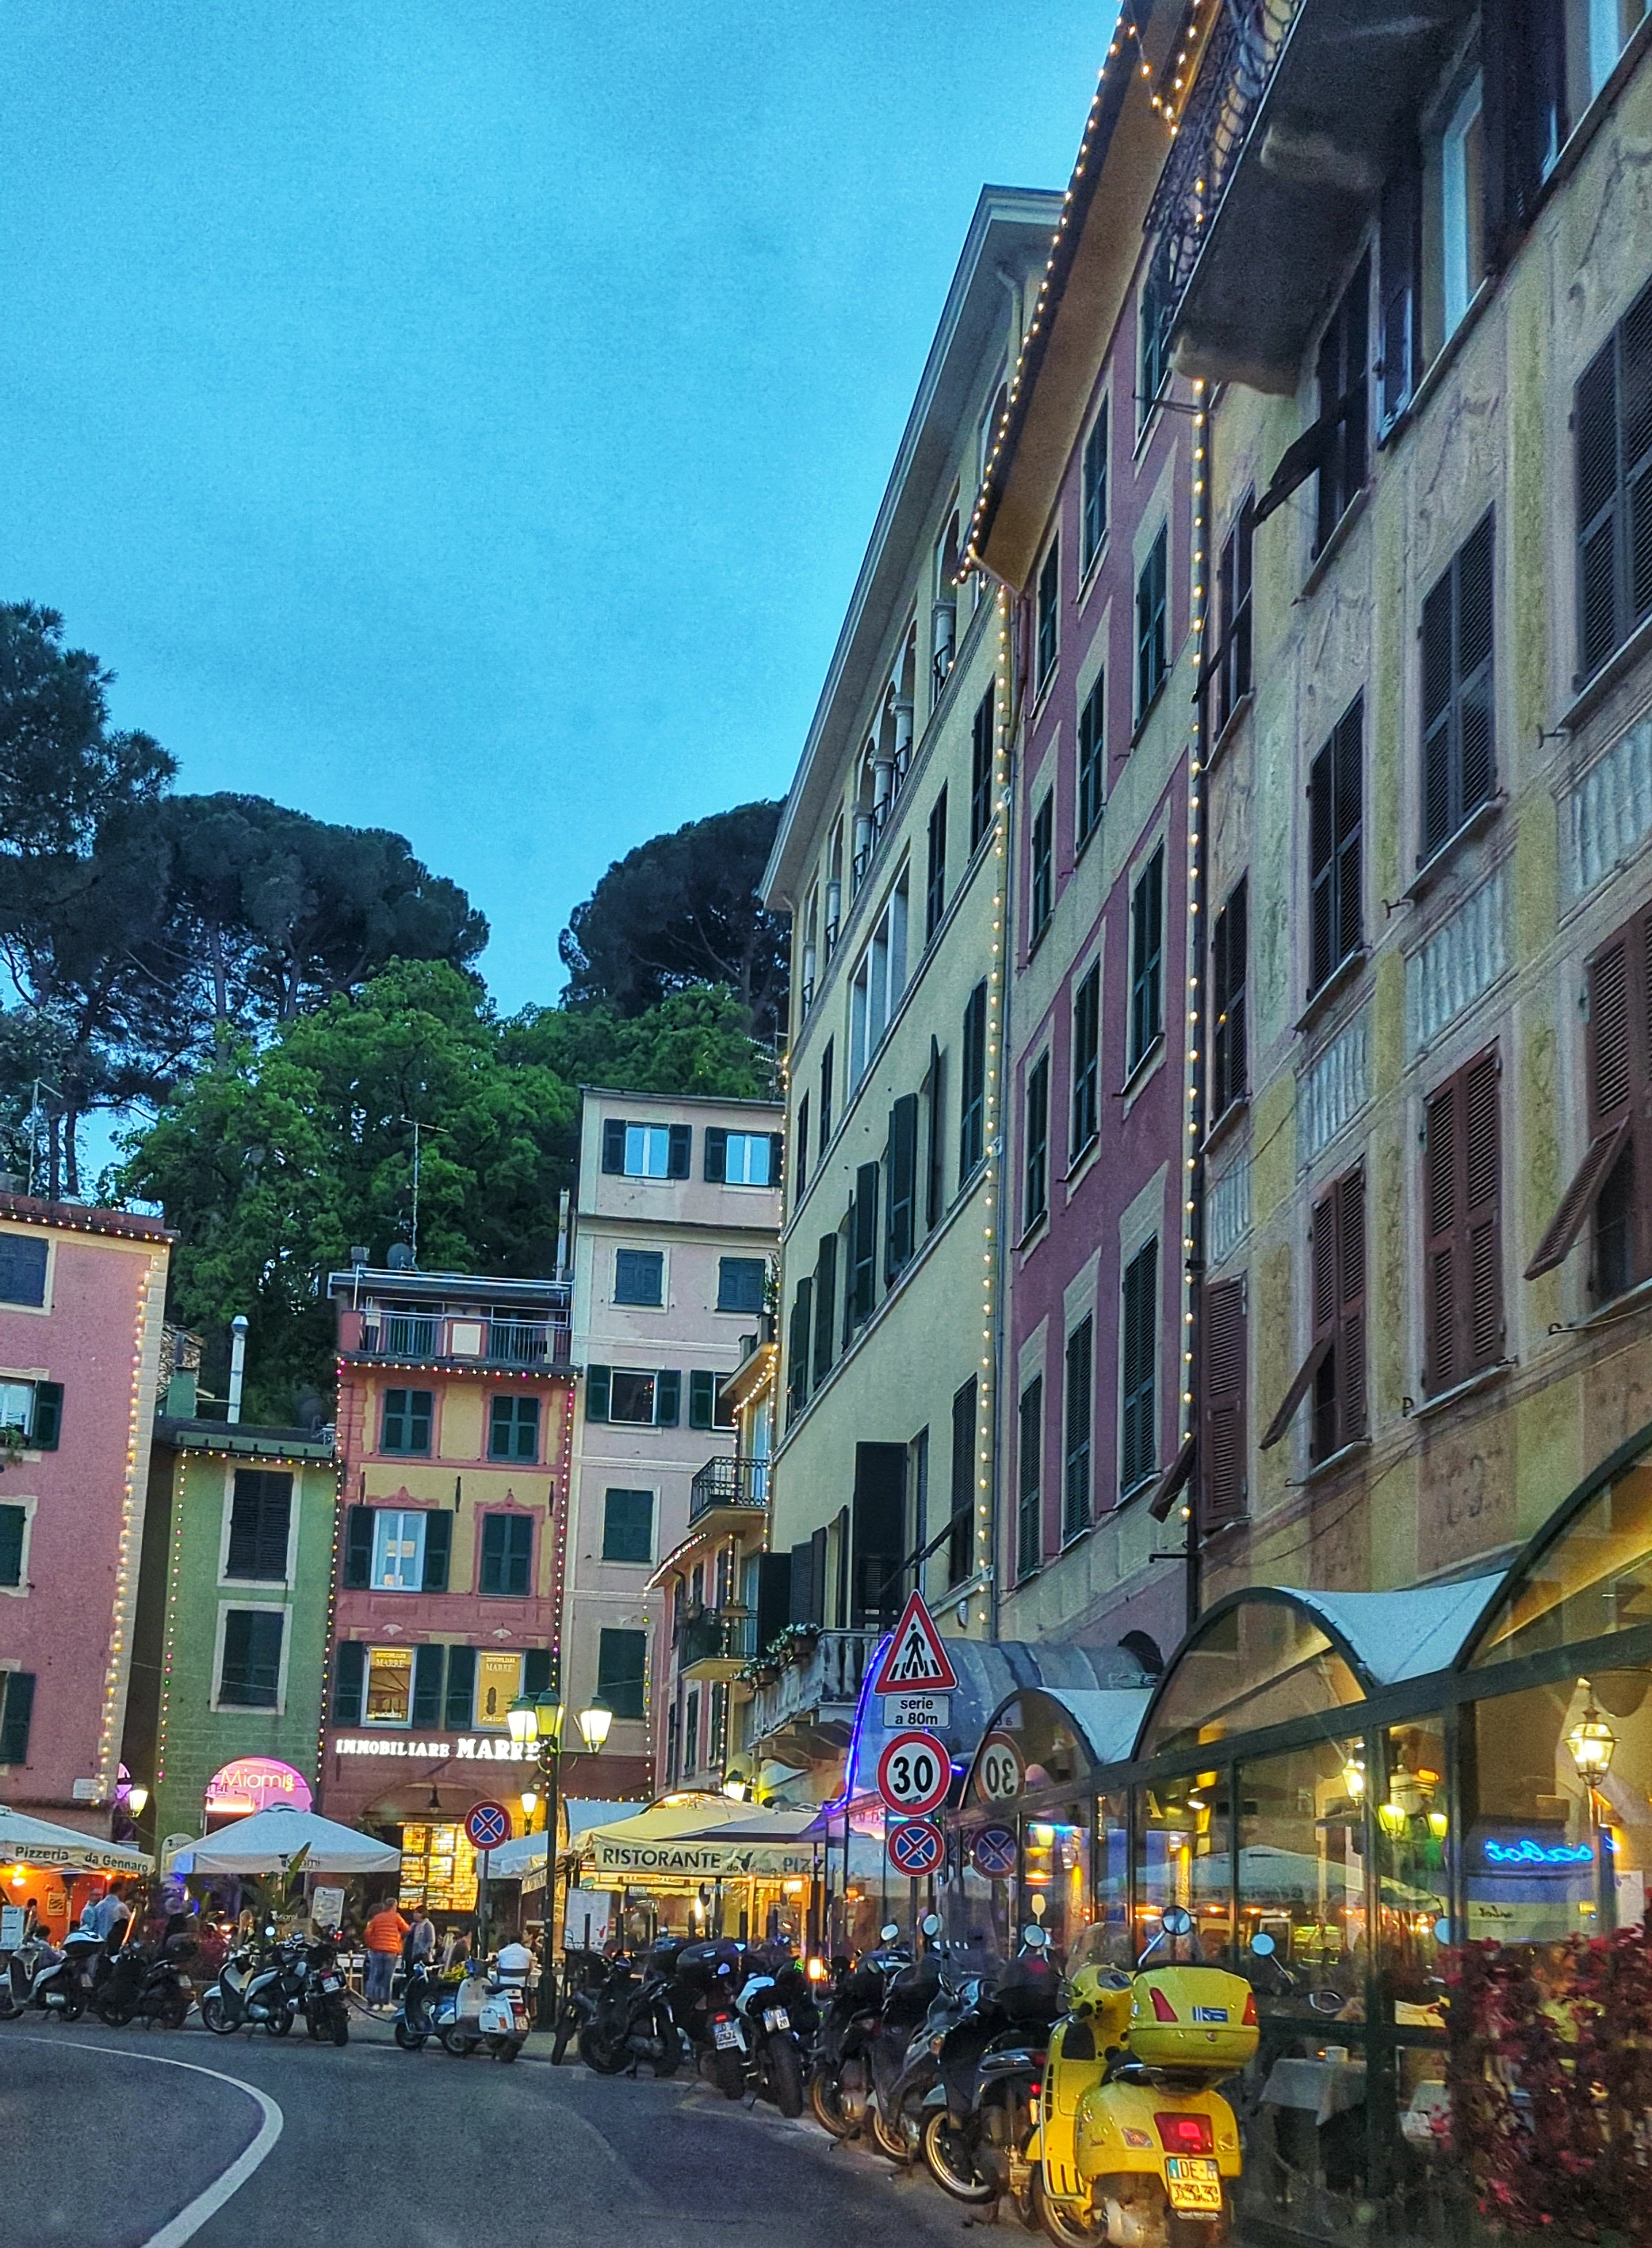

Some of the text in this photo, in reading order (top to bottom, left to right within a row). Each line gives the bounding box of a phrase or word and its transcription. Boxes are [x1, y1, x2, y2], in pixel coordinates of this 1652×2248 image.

[900, 1697, 934, 1710] serie
[895, 1713, 938, 1725] a 80m
[335, 1739, 450, 1758] IMMOBILIARE
[219, 1768, 286, 1788] Miami
[893, 1755, 934, 1795] 30
[15, 1846, 149, 1873] Pizzeria da Gennaro
[602, 1847, 721, 1868] RISTORANTE
